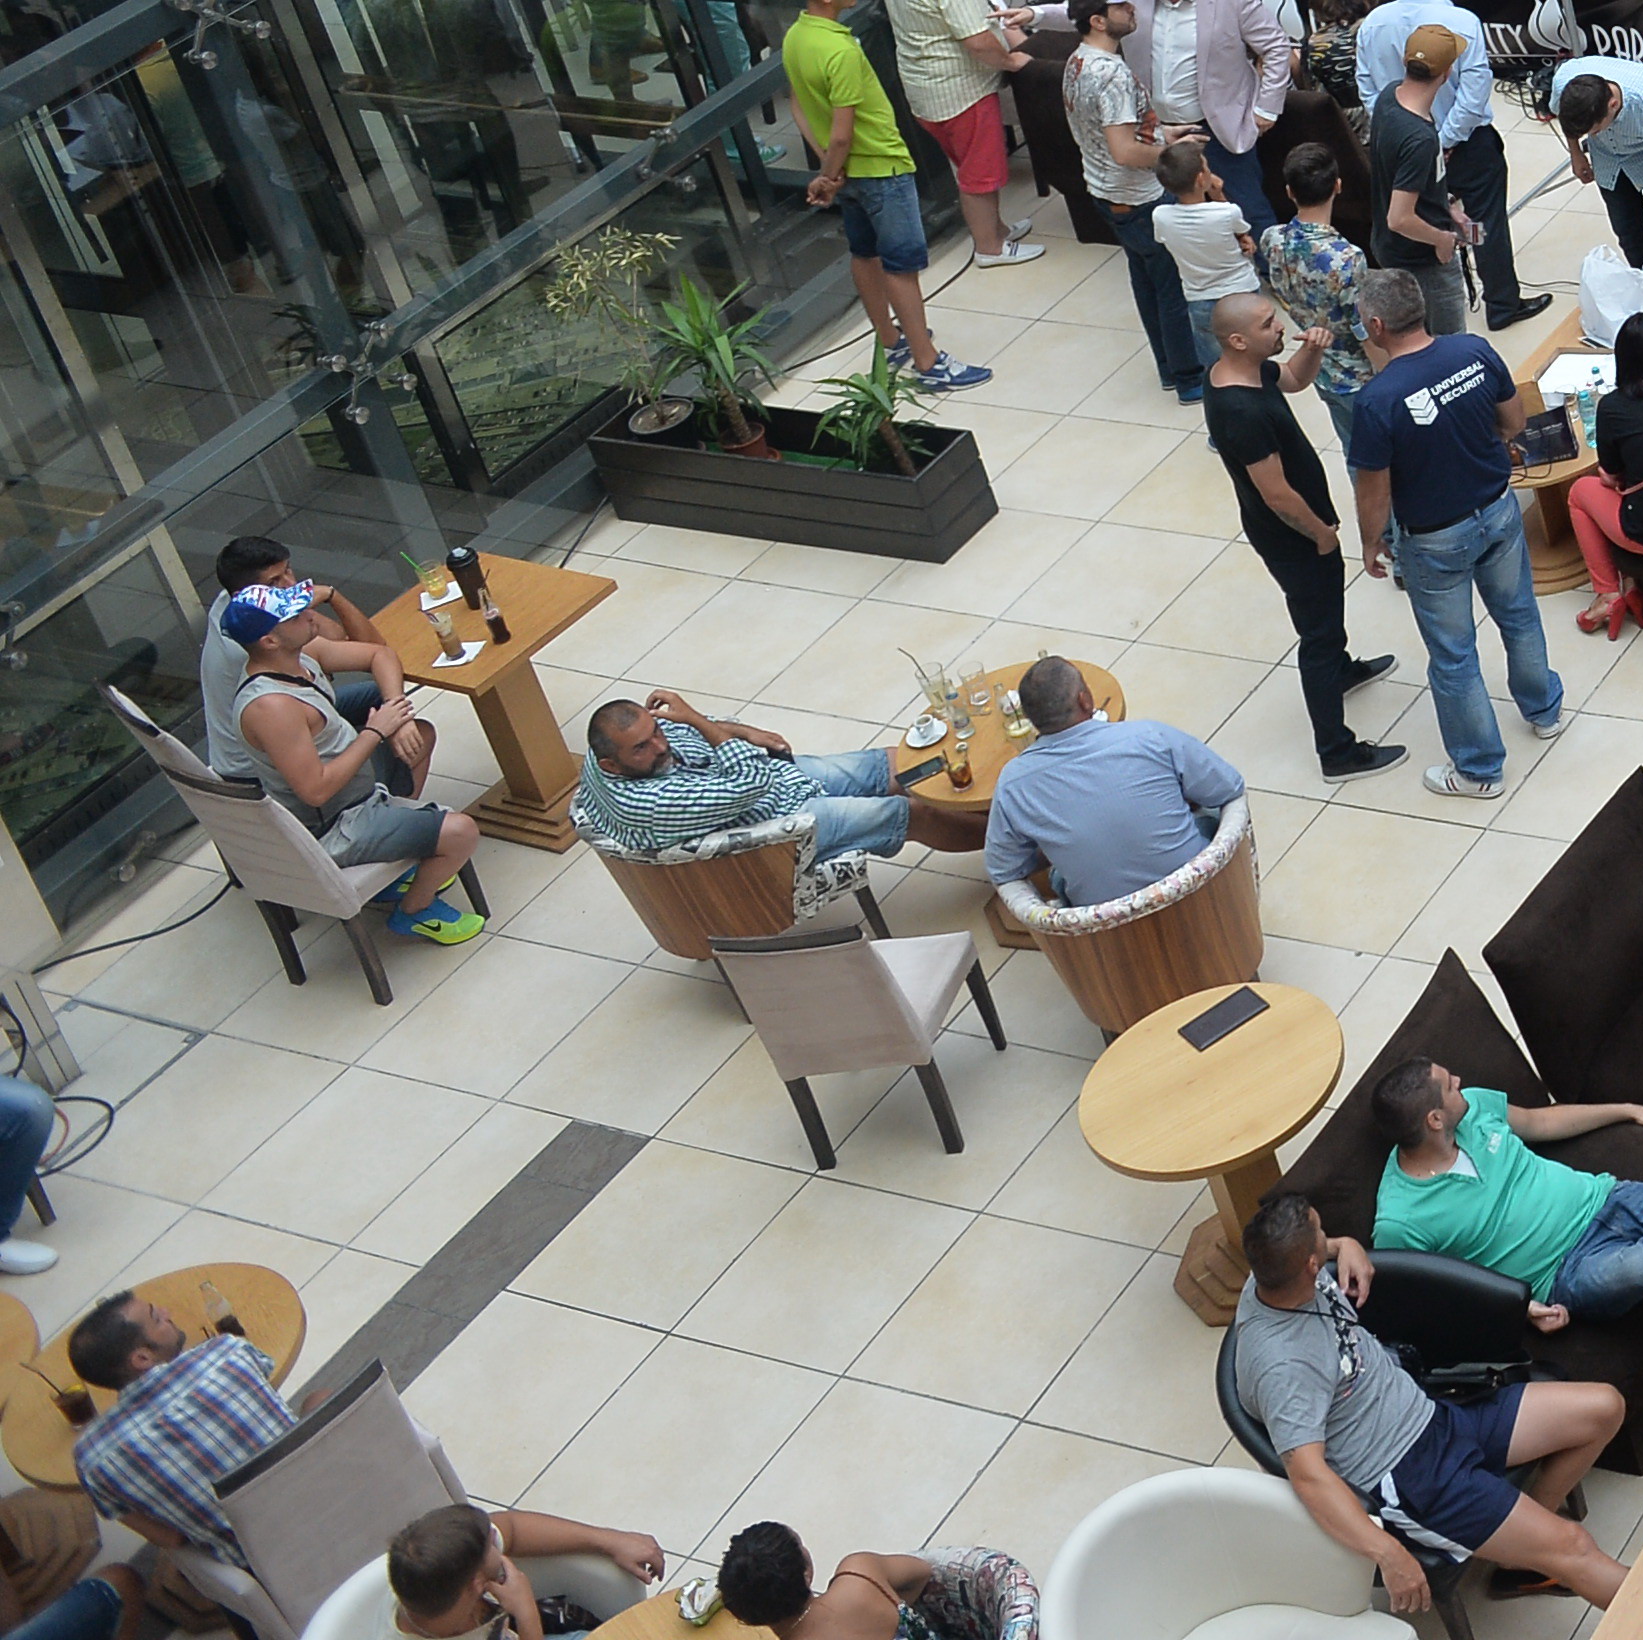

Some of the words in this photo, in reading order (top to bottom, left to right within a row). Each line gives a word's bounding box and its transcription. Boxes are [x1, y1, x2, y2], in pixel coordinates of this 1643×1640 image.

[1483, 23, 1529, 55] ITY
[1429, 361, 1486, 396] UNIVERSAL
[1439, 372, 1486, 406] SECURITY
